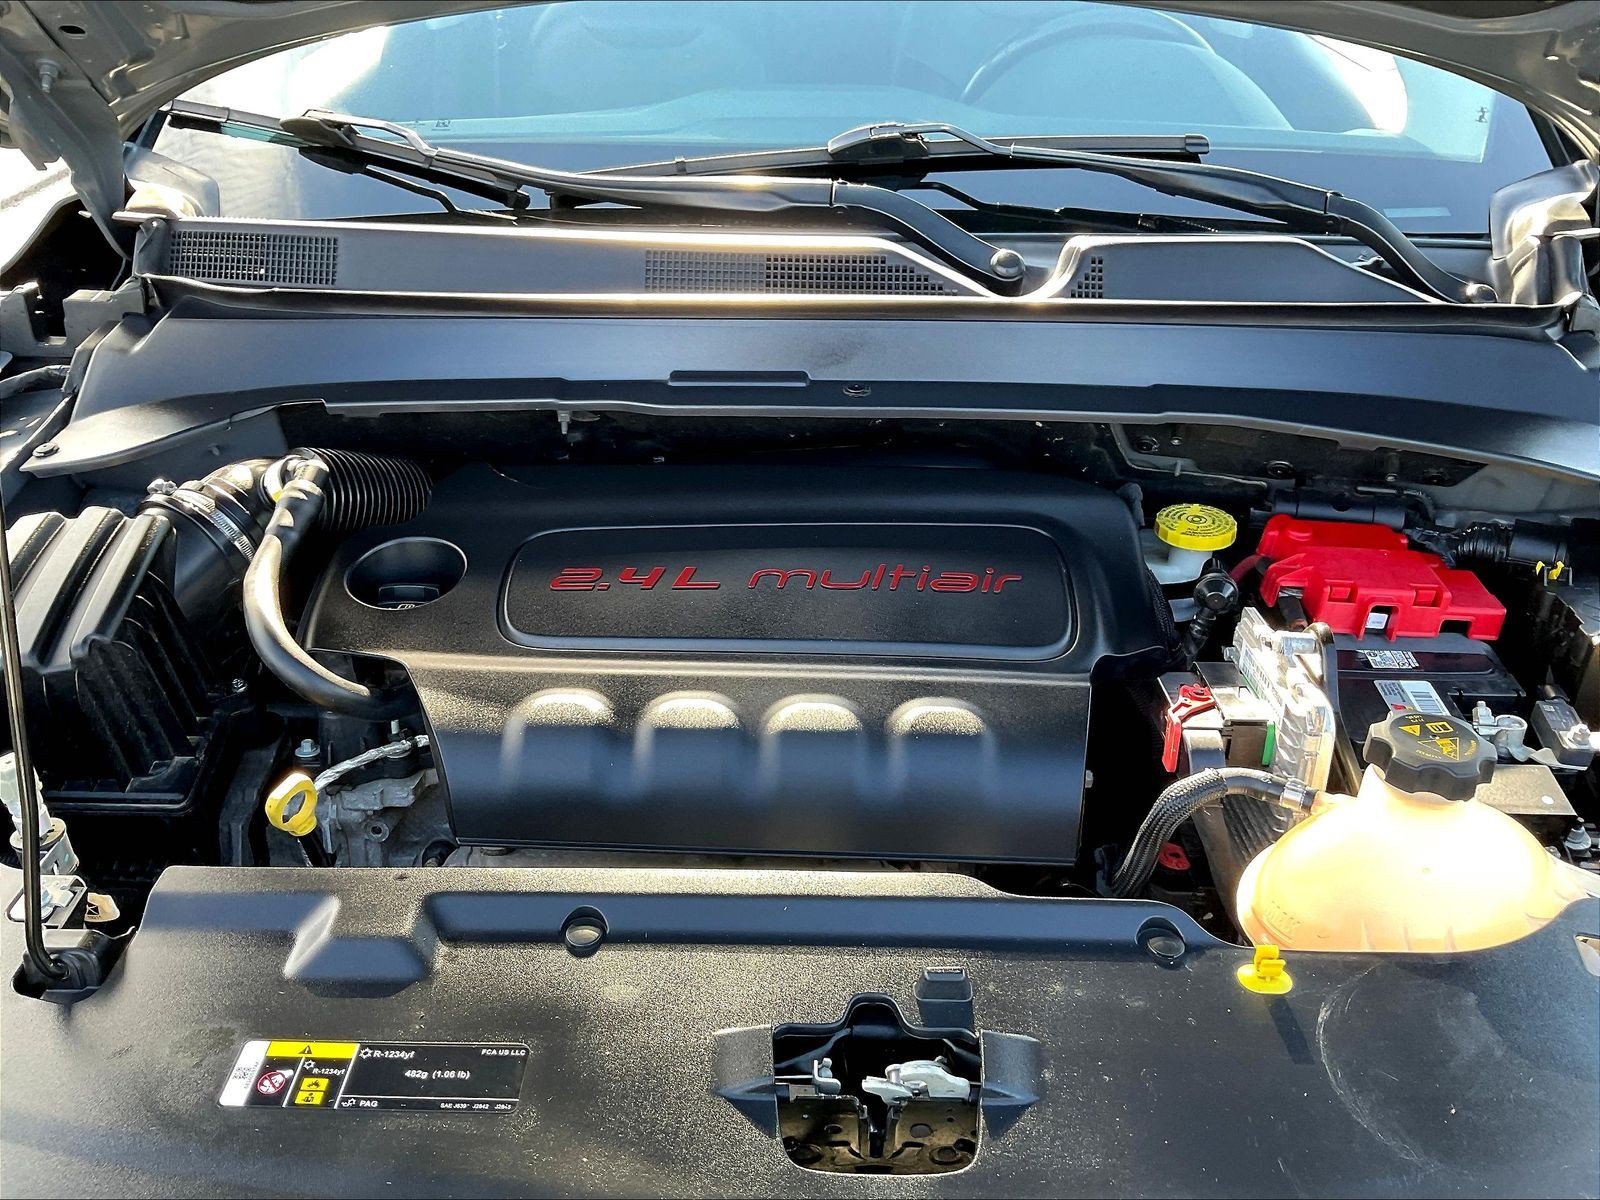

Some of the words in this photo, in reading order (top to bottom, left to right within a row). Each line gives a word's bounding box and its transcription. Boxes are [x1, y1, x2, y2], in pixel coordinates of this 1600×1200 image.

[748, 563, 1023, 593] multiair
[373, 1049, 416, 1060] R-1234yf
[511, 1049, 527, 1057] LLC
[311, 1068, 346, 1076] R-1234yf
[404, 1069, 429, 1080] 482g
[432, 1070, 456, 1080] (1.06
[457, 1070, 471, 1080] lb)
[359, 1100, 379, 1108] PAG
